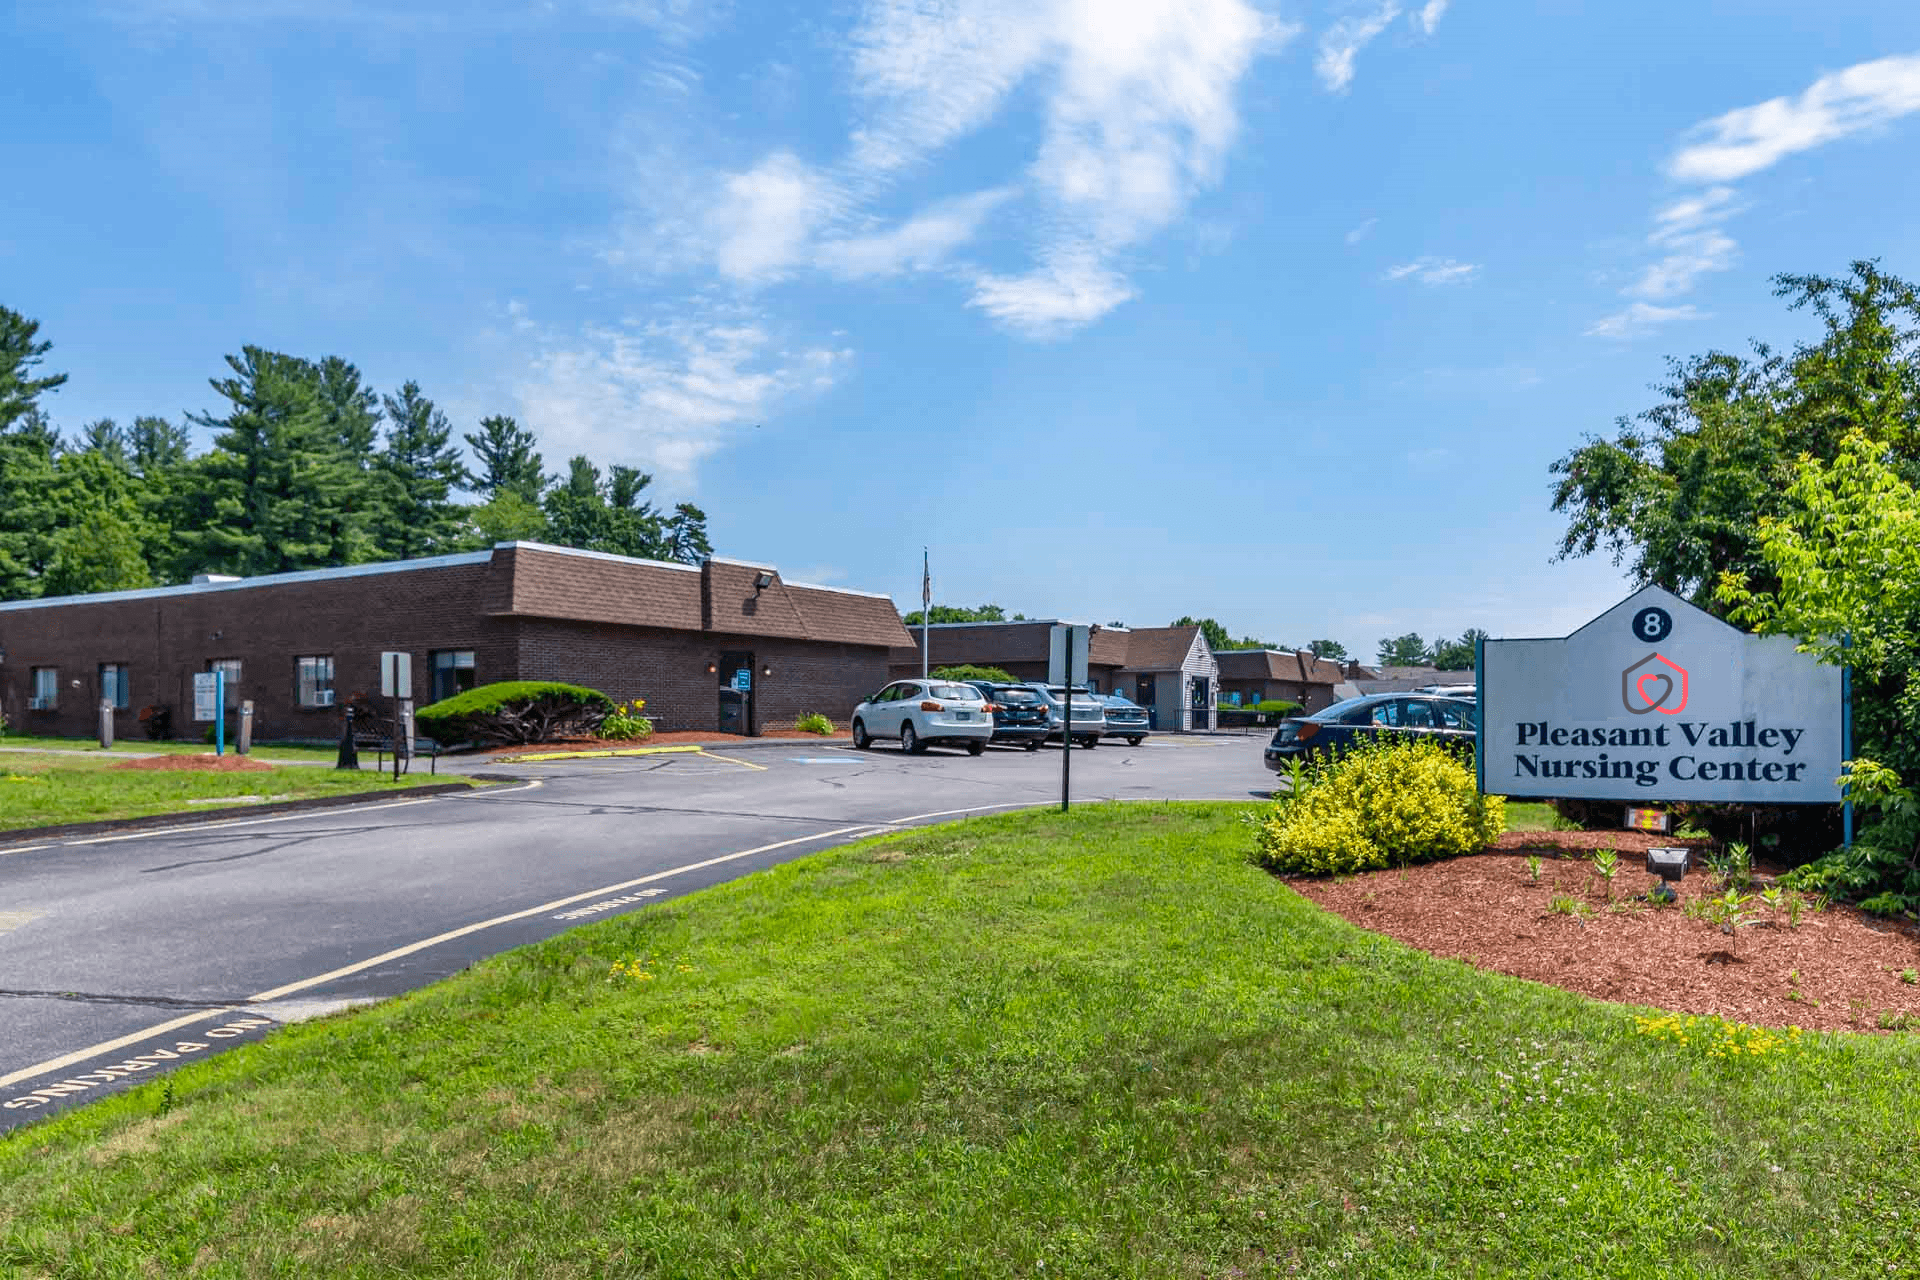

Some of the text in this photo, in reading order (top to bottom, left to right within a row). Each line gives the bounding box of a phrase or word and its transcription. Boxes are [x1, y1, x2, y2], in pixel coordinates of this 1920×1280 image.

[1643, 612, 1662, 637] 8
[1515, 719, 1805, 755] Pleasant Valley
[1514, 753, 1807, 787] Nursing Center
[551, 888, 669, 920] NO PARKING
[3, 1018, 273, 1109] NO PARKING
